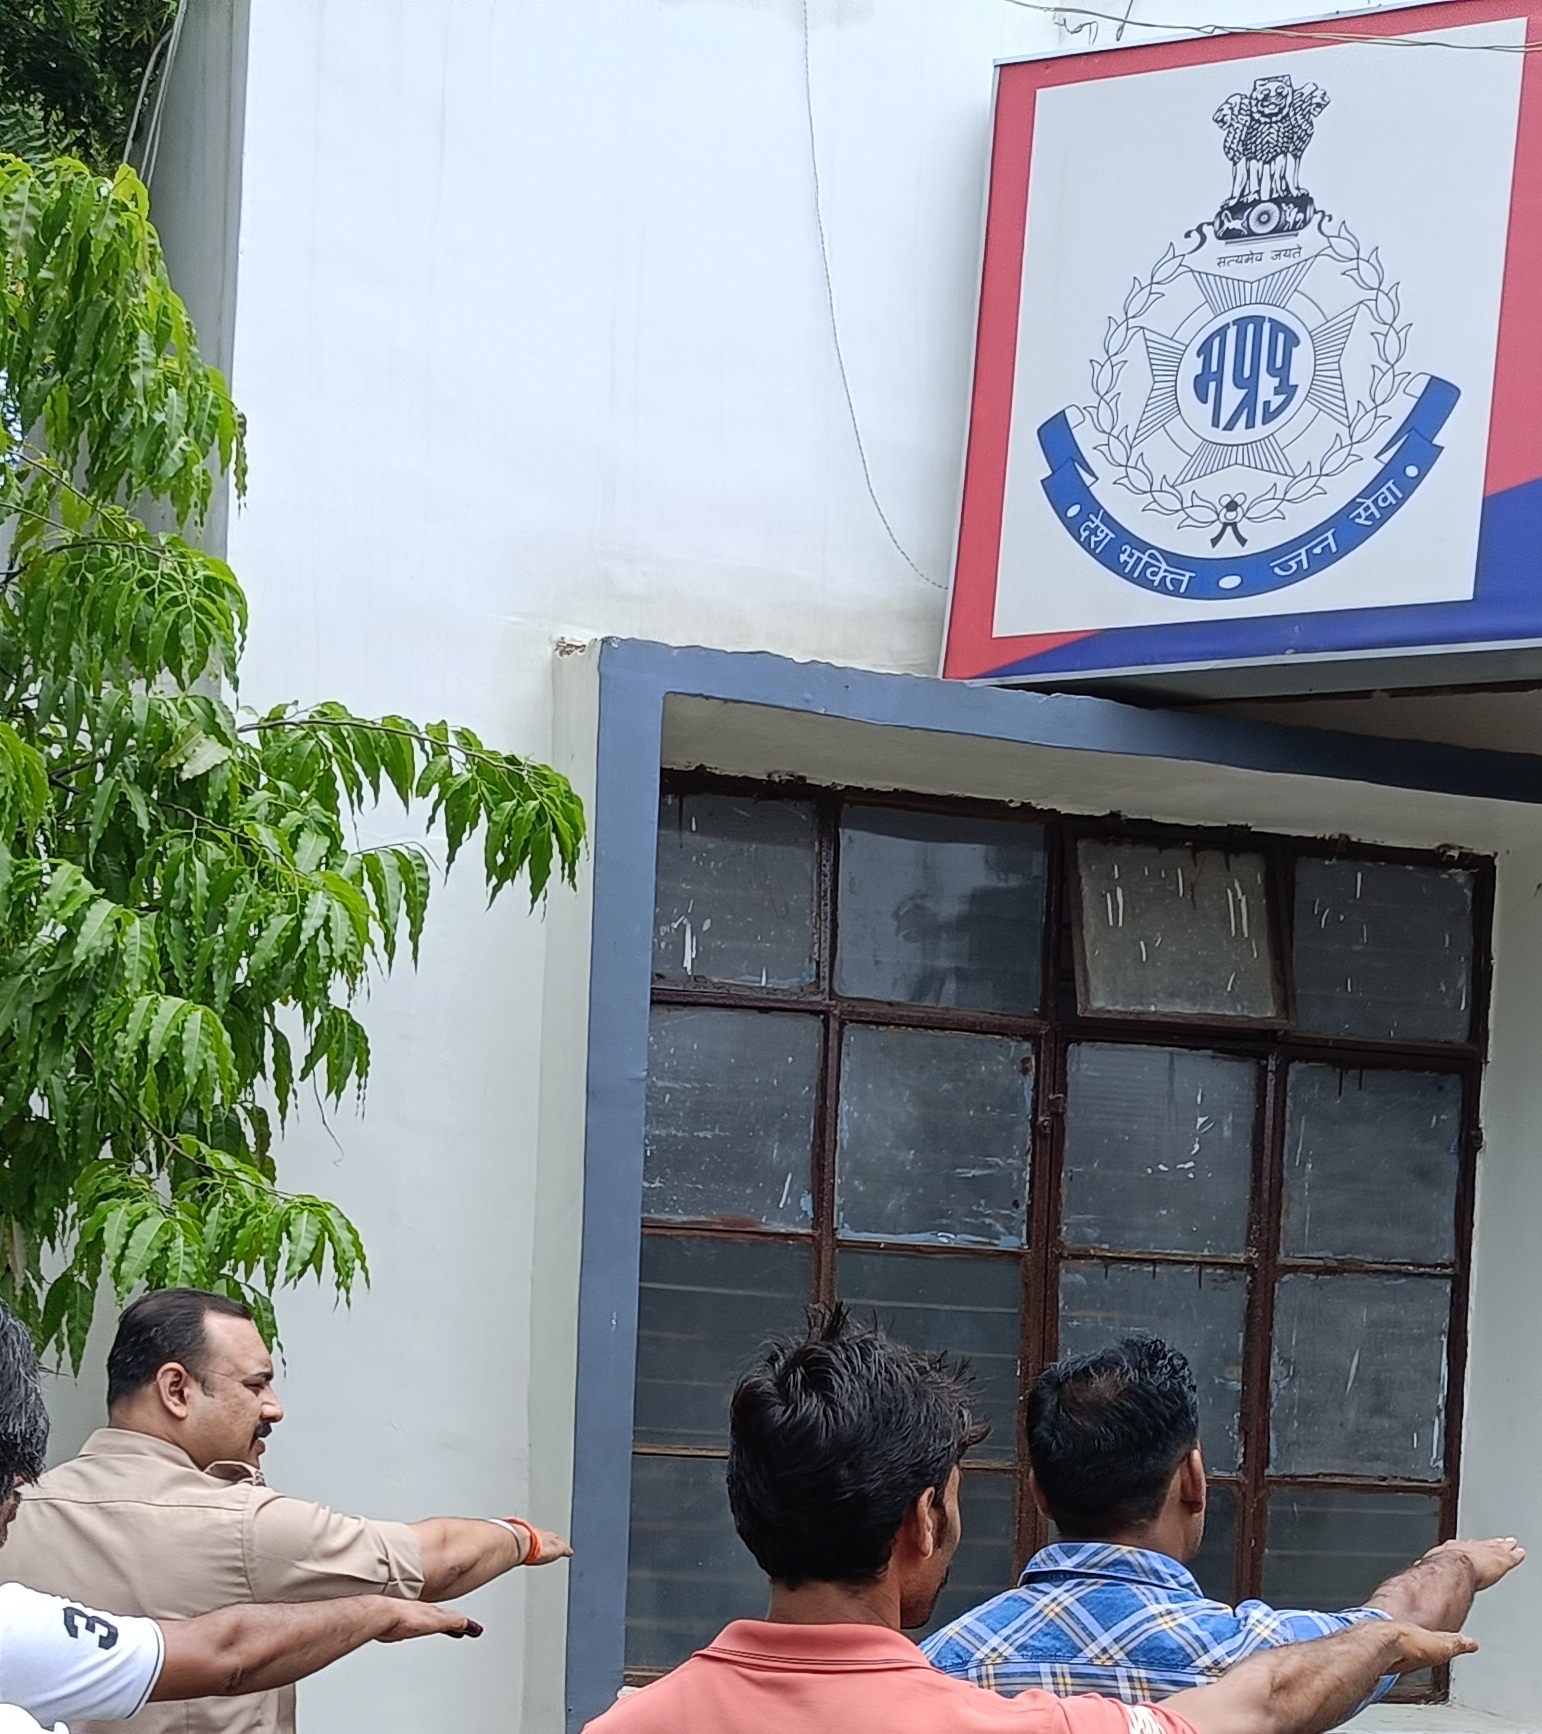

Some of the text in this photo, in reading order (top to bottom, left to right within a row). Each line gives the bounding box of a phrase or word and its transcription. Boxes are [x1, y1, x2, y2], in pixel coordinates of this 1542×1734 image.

[1216, 246, 1302, 268] सत्यमेव जयते
[1079, 479, 1404, 594] देश भक्ति जन सेवा
[62, 1606, 119, 1650] 3
